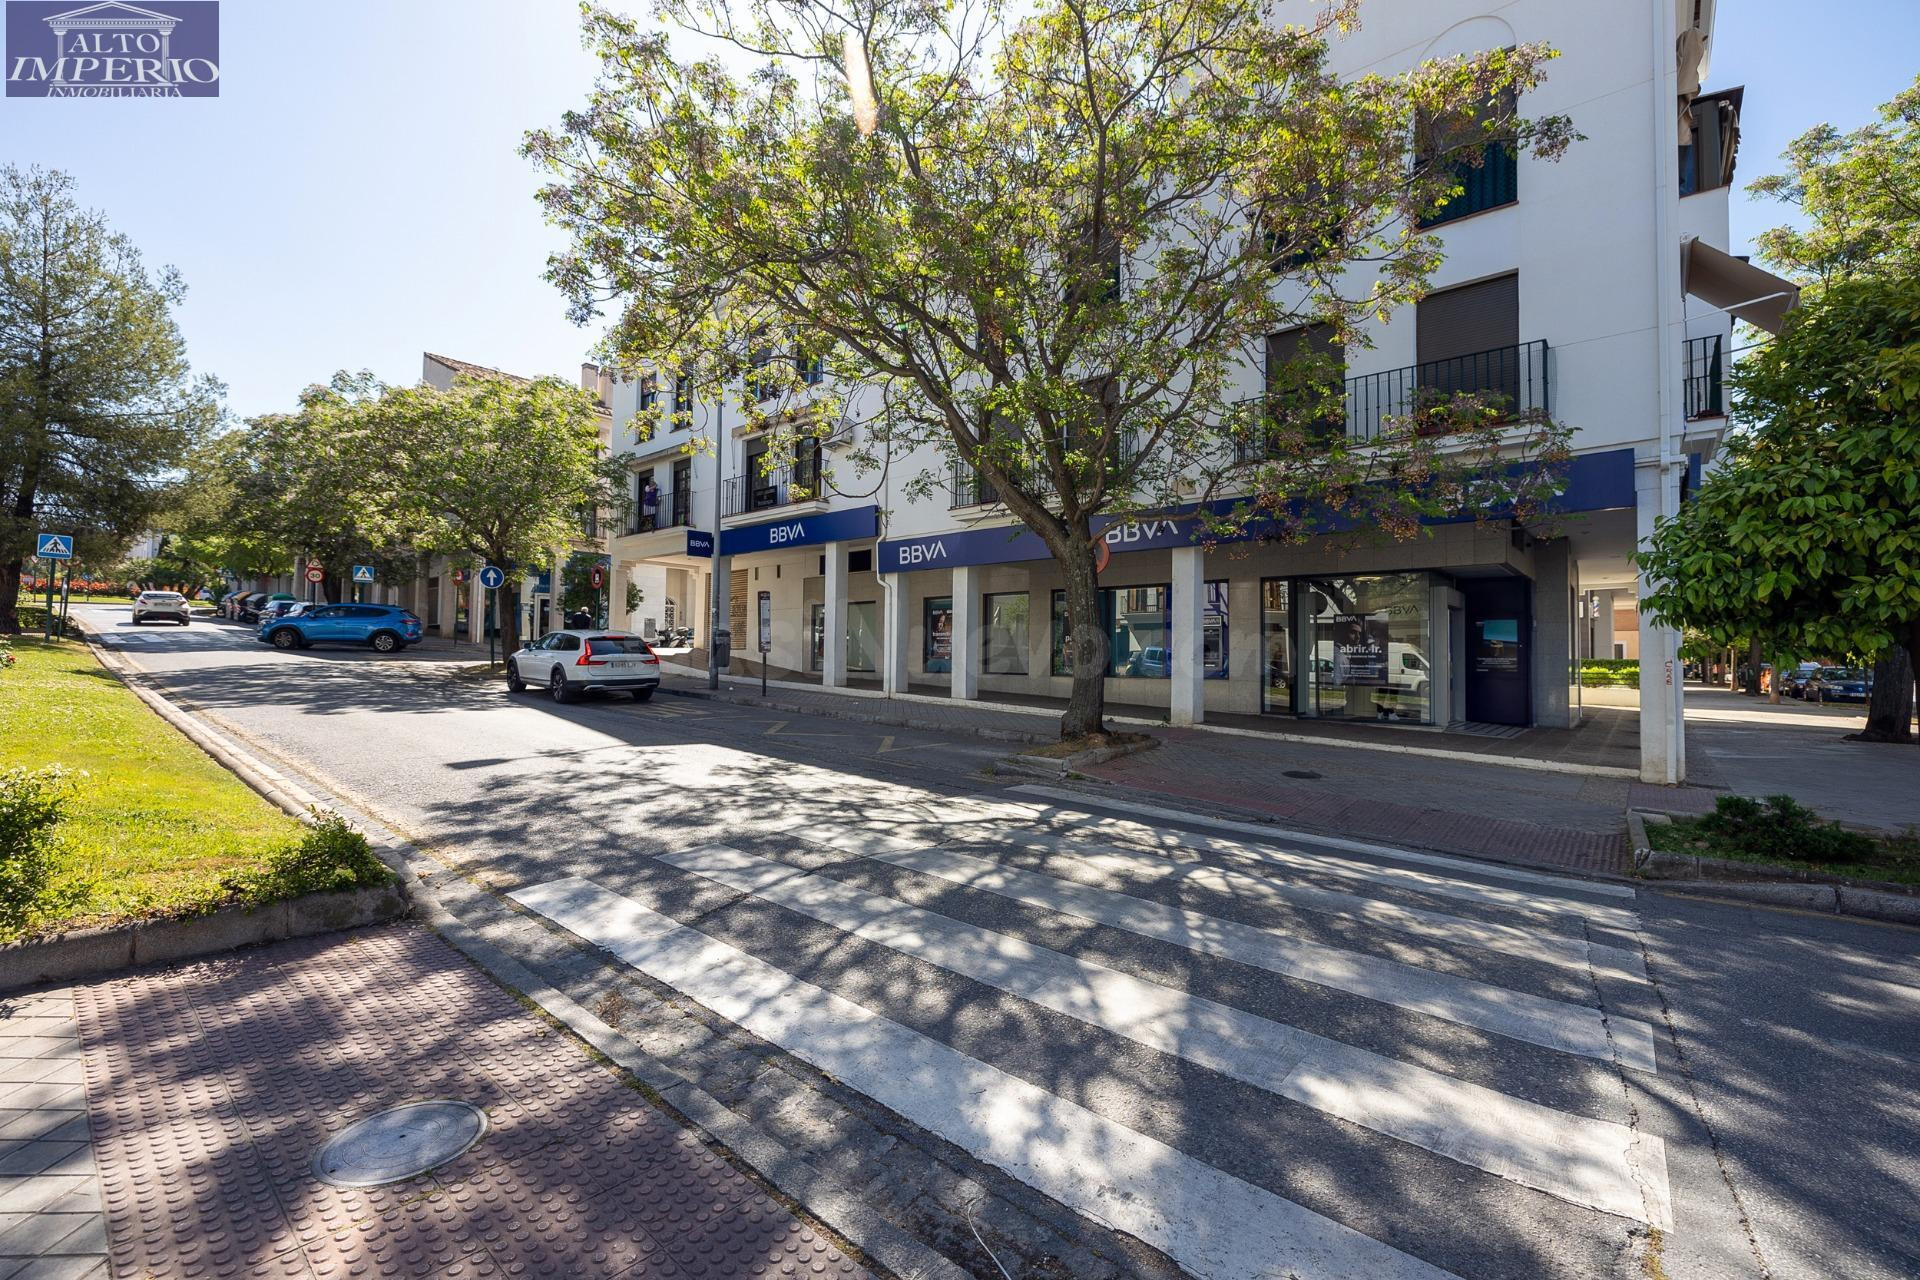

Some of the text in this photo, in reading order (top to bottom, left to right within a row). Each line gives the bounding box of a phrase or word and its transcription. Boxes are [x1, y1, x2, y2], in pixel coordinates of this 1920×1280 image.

[769, 522, 805, 544] BBVA
[1105, 519, 1179, 544] BBVA
[690, 539, 710, 548] BBVA
[899, 540, 947, 565] BBVA
[1335, 615, 1357, 623] BBVA
[1340, 644, 1369, 653] abrir.
